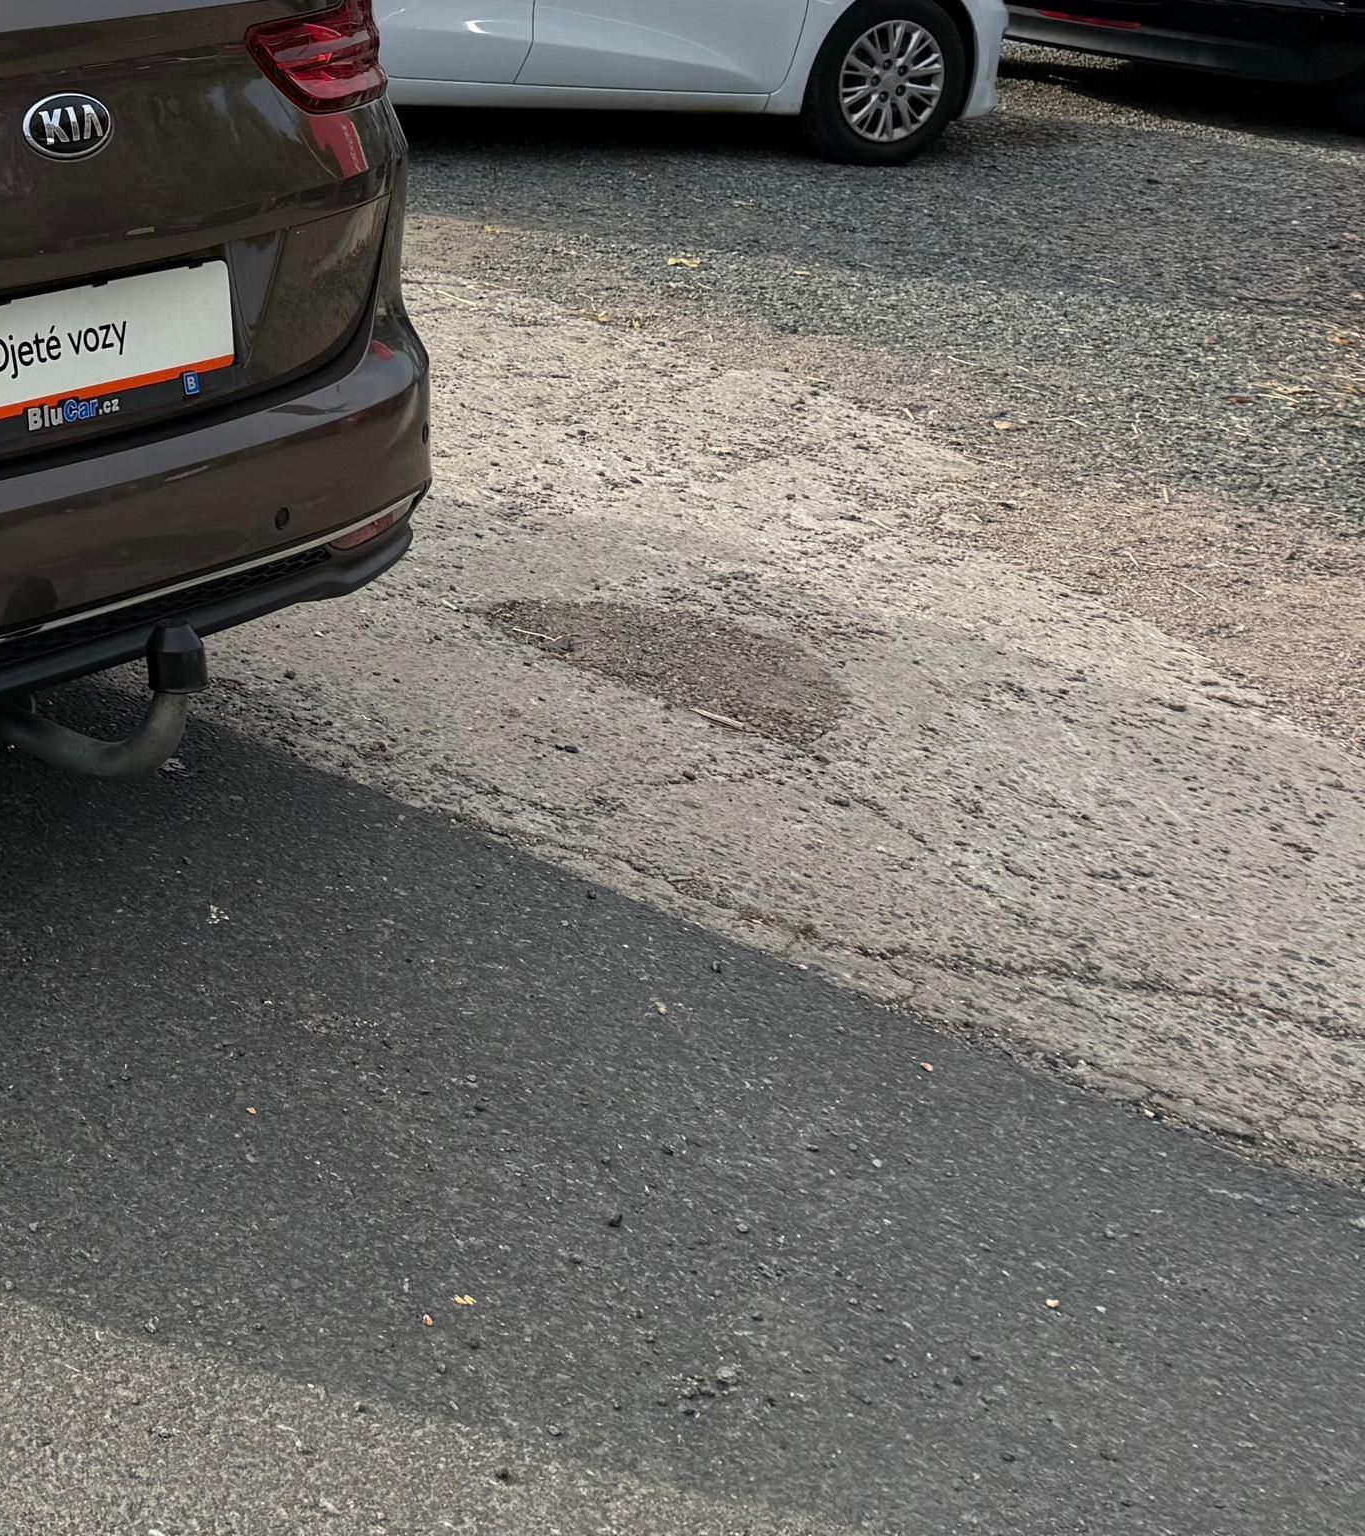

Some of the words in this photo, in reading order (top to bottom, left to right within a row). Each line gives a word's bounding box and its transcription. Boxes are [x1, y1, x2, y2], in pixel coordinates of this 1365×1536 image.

[38, 104, 104, 145] KIA
[67, 320, 127, 355] vozy
[27, 398, 120, 431] BluCar.cz
